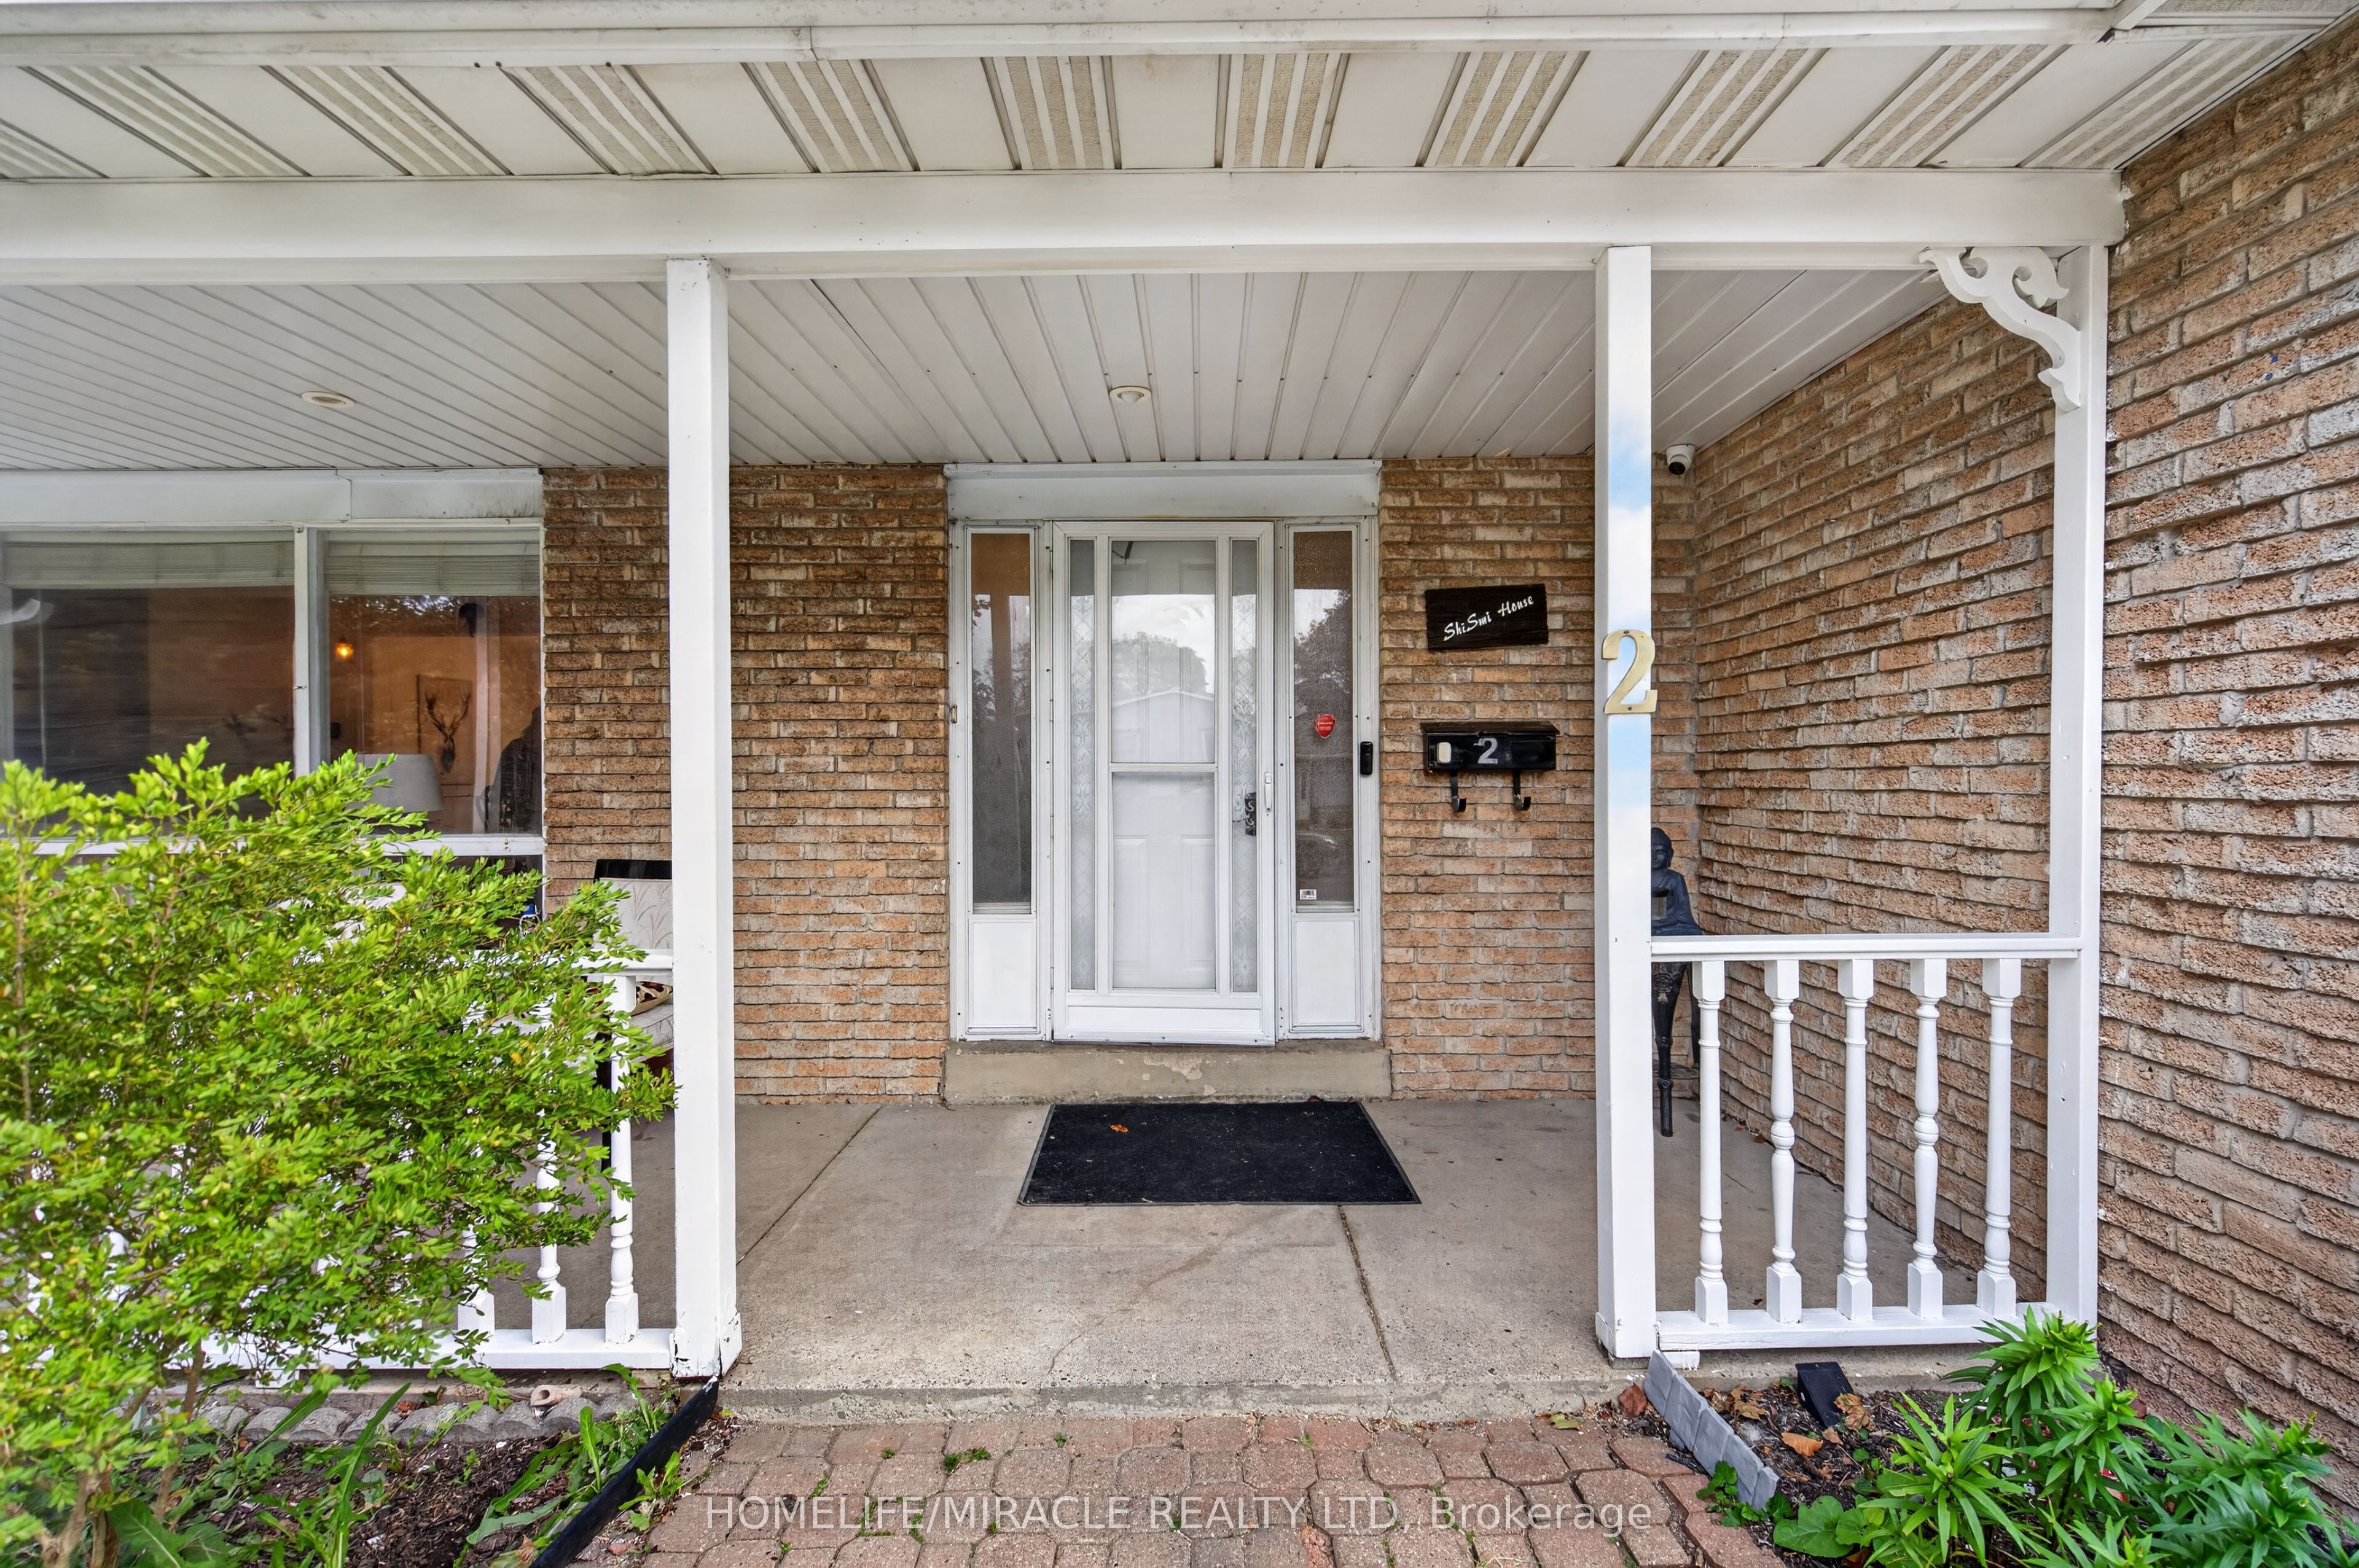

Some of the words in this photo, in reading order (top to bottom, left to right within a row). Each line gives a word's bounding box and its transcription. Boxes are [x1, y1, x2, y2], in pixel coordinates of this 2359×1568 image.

[1497, 596, 1534, 617] House
[1602, 629, 1657, 714] 2
[1474, 737, 1498, 765] 2
